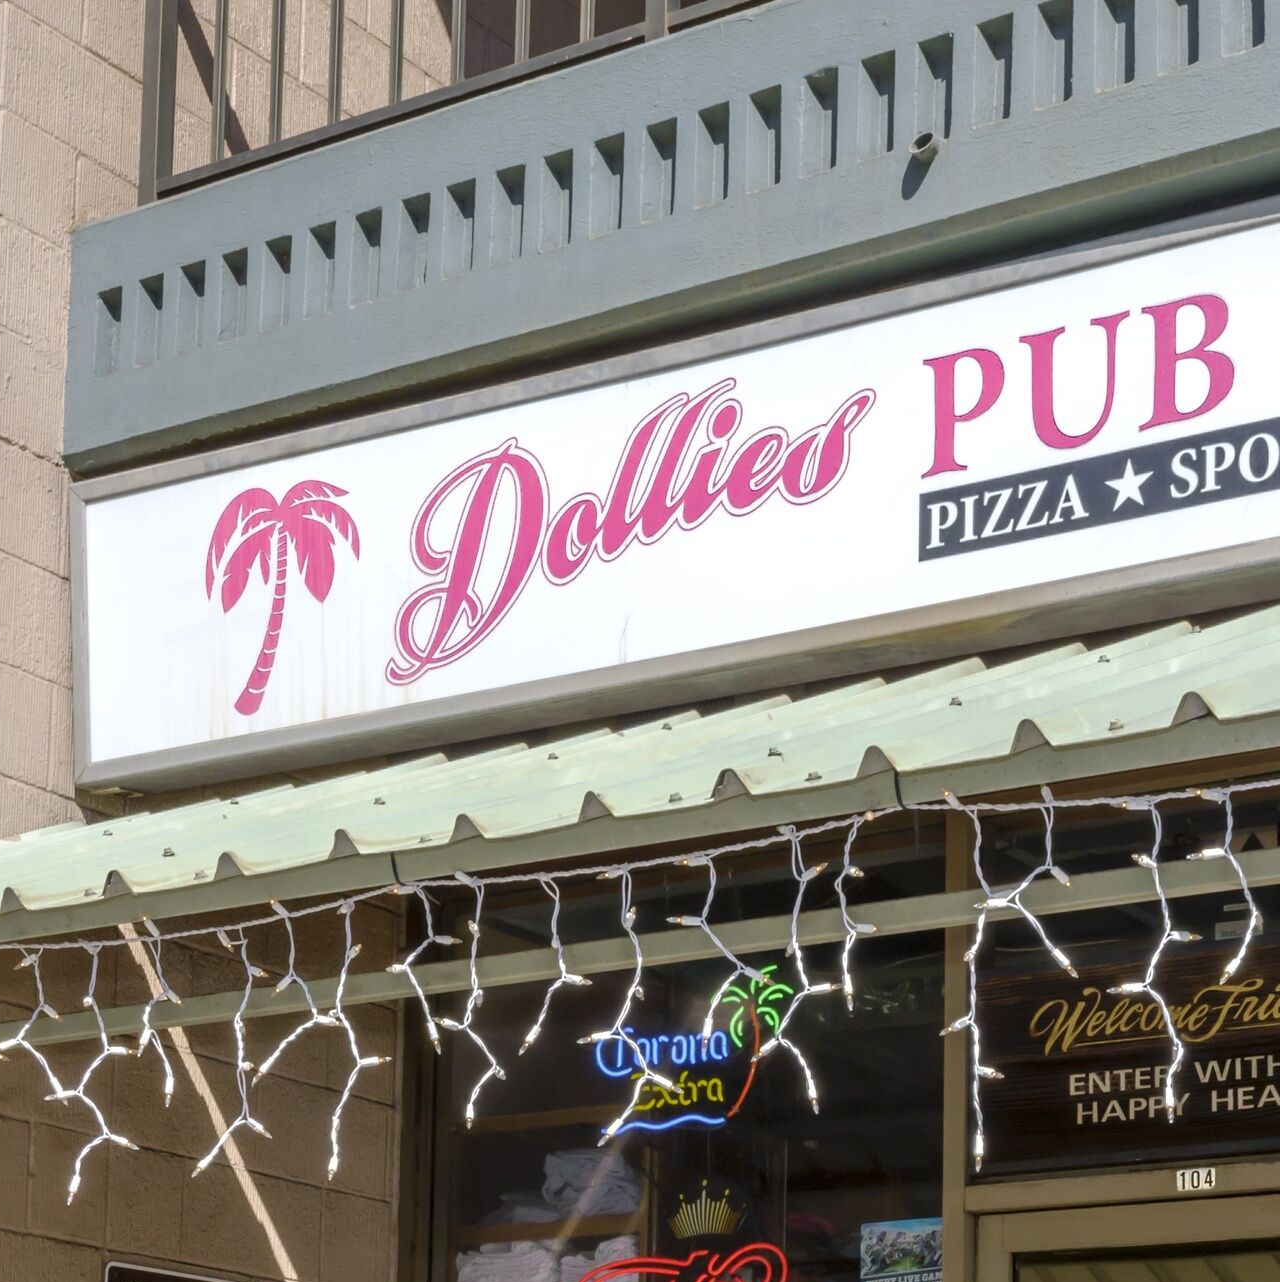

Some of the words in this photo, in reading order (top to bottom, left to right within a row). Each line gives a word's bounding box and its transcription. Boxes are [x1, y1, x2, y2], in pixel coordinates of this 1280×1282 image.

[921, 293, 1235, 478] PUB
[386, 377, 876, 685] Dollies
[926, 474, 1089, 550] PIZZA
[1030, 988, 1207, 1056] Welcome
[596, 1027, 728, 1077] Corona
[631, 1071, 723, 1112] Extra
[1076, 1093, 1189, 1125] HAPPY
[1179, 1170, 1214, 1190] 104
